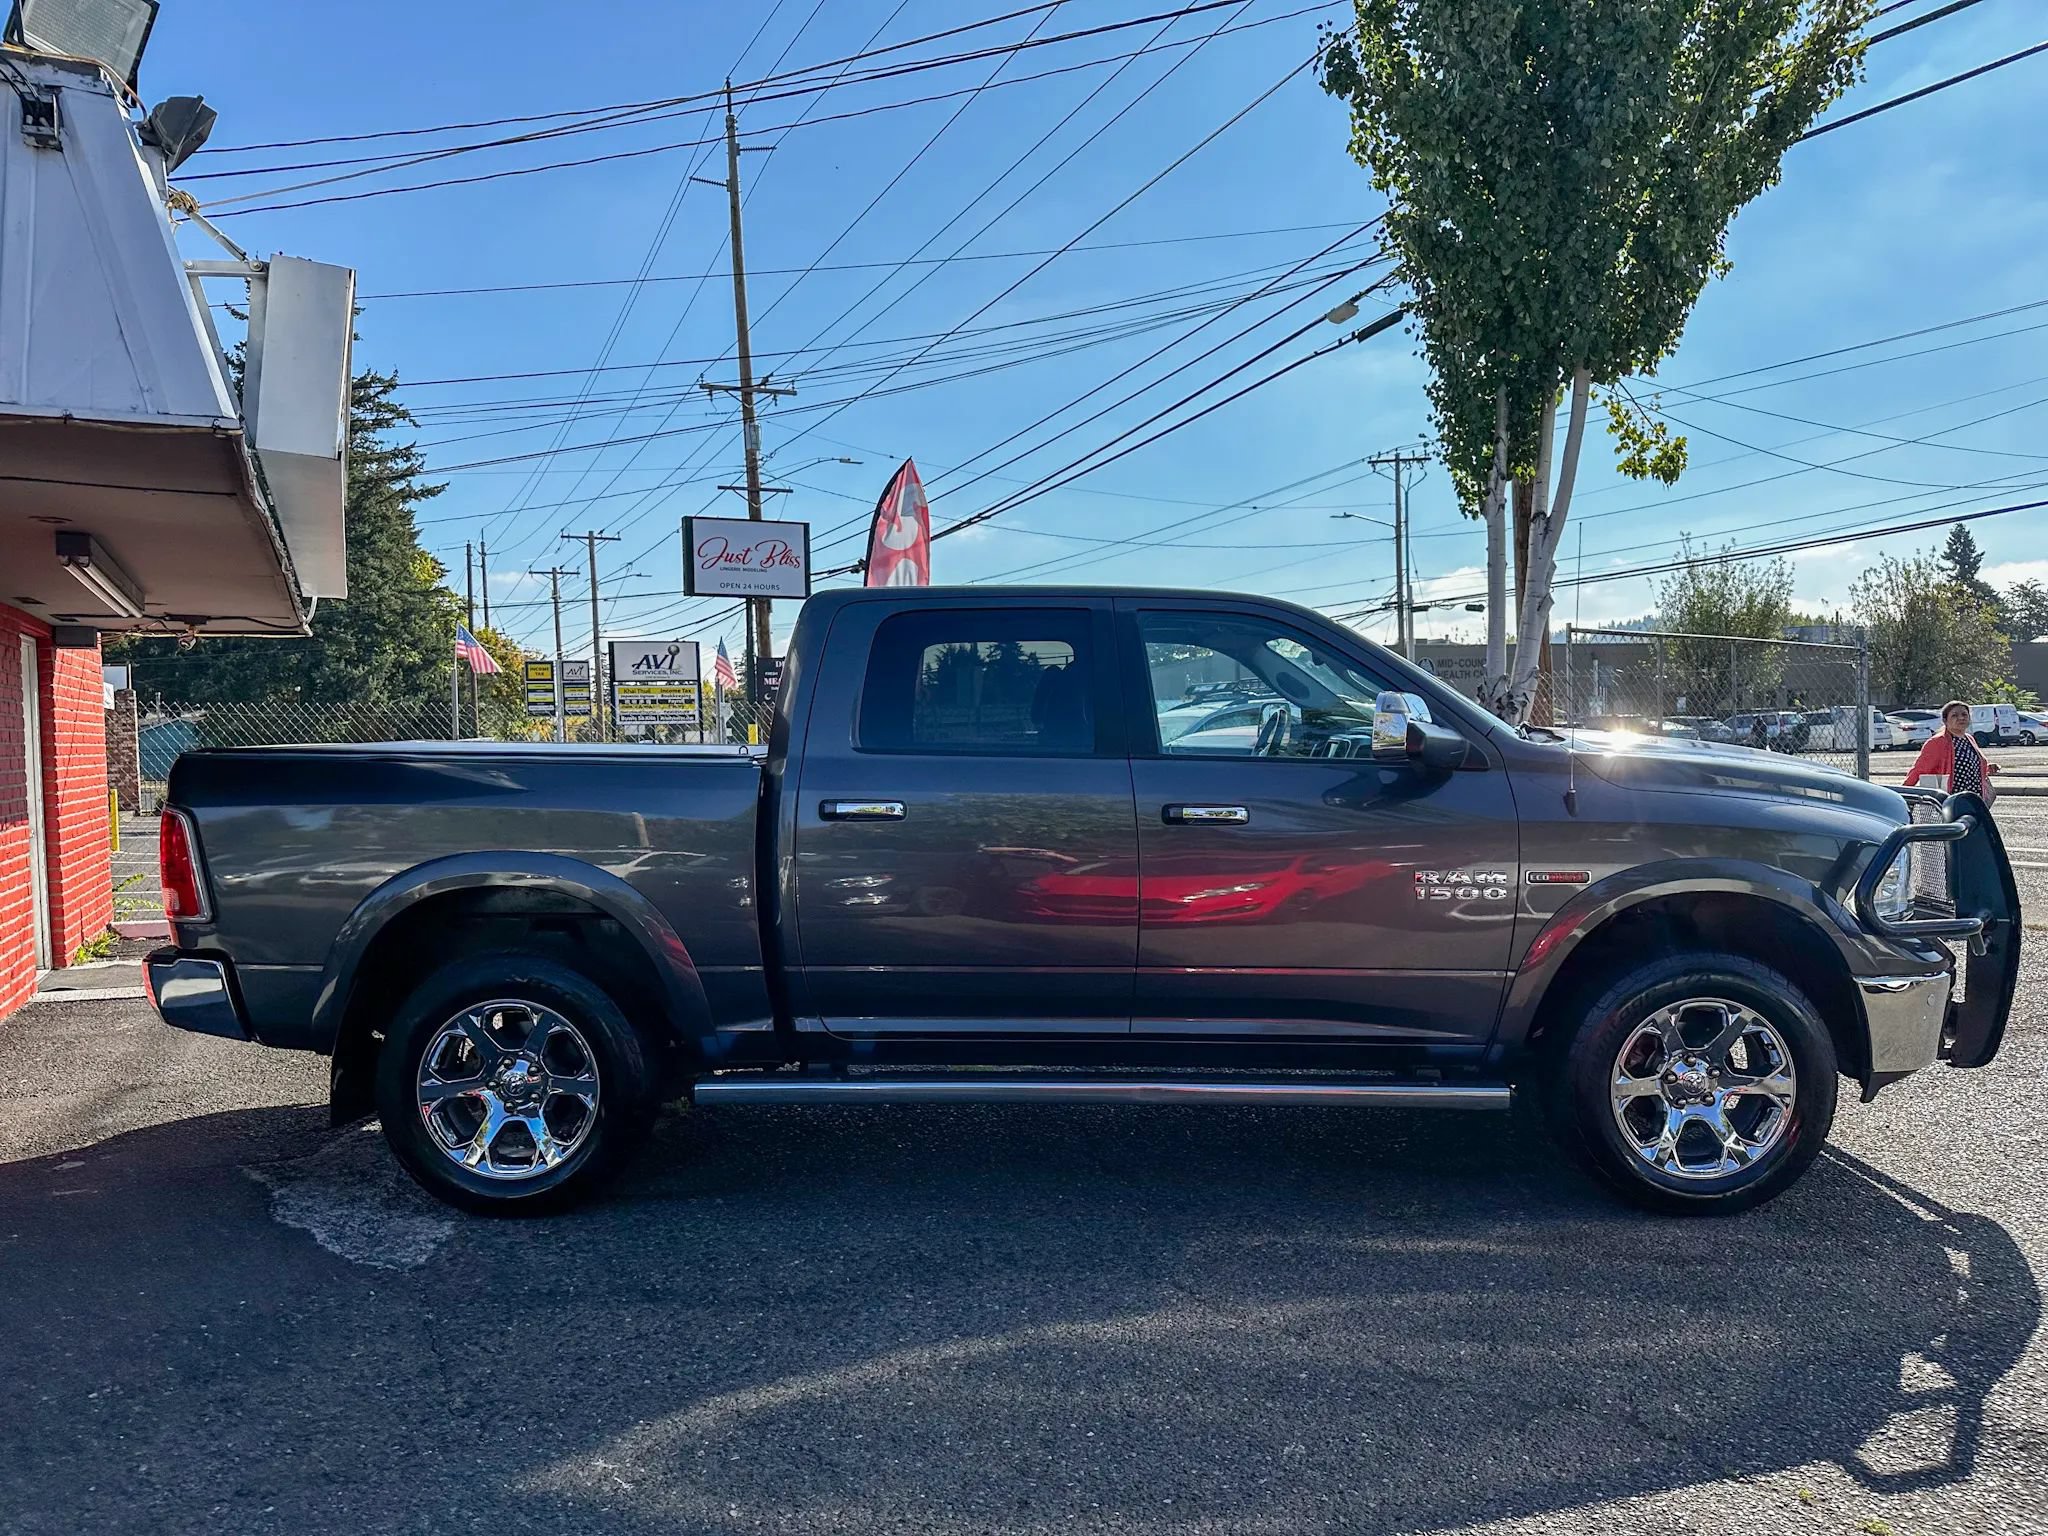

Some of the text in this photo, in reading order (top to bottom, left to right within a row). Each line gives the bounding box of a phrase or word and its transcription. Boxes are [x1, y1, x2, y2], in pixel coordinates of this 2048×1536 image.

[697, 536, 801, 570] Just Bliss
[754, 583, 780, 591] HOURS
[1414, 870, 1508, 885] RAM
[1415, 886, 1508, 900] 1500
